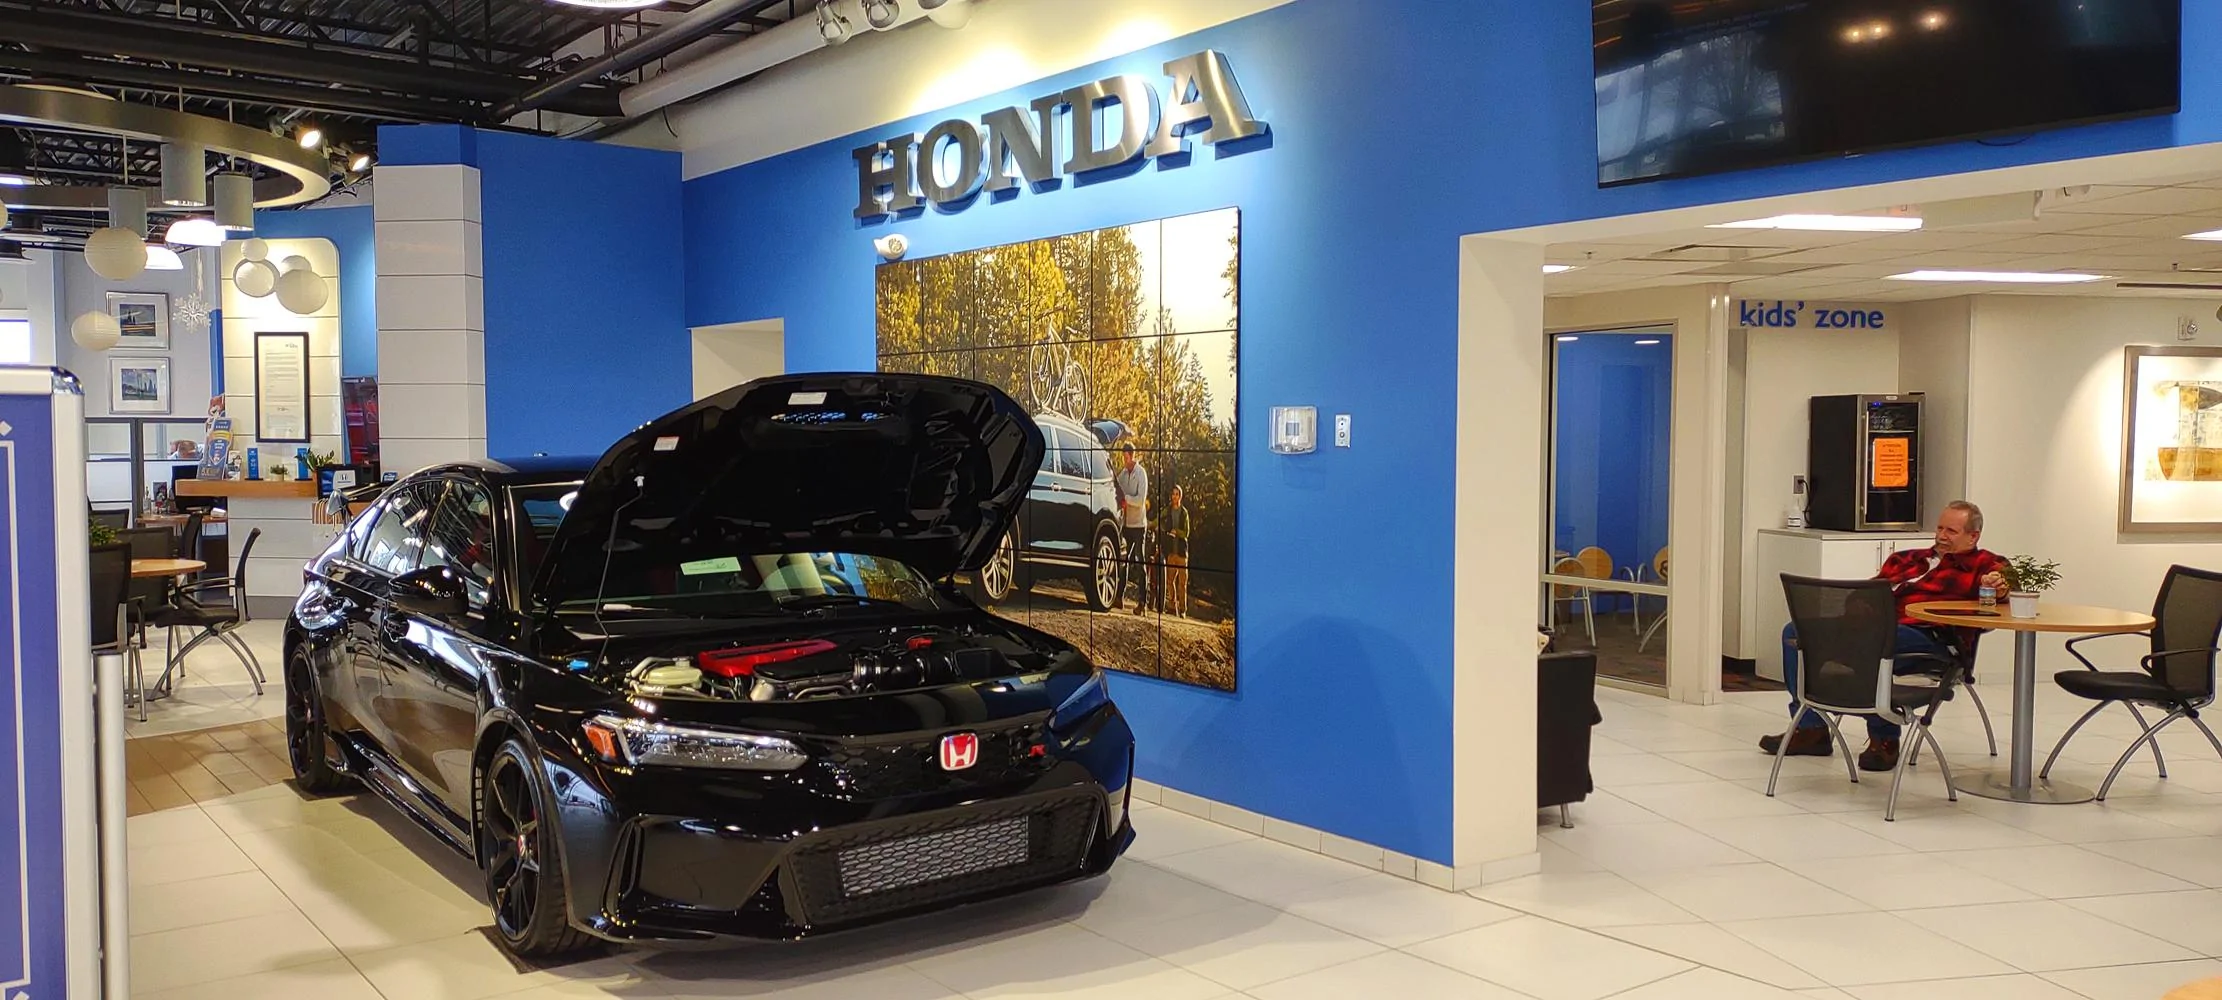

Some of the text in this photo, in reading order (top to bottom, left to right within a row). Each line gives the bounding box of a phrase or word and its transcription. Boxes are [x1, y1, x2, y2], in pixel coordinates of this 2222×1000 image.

[852, 49, 1269, 218] HONDA
[1740, 299, 1884, 329] kids' zone
